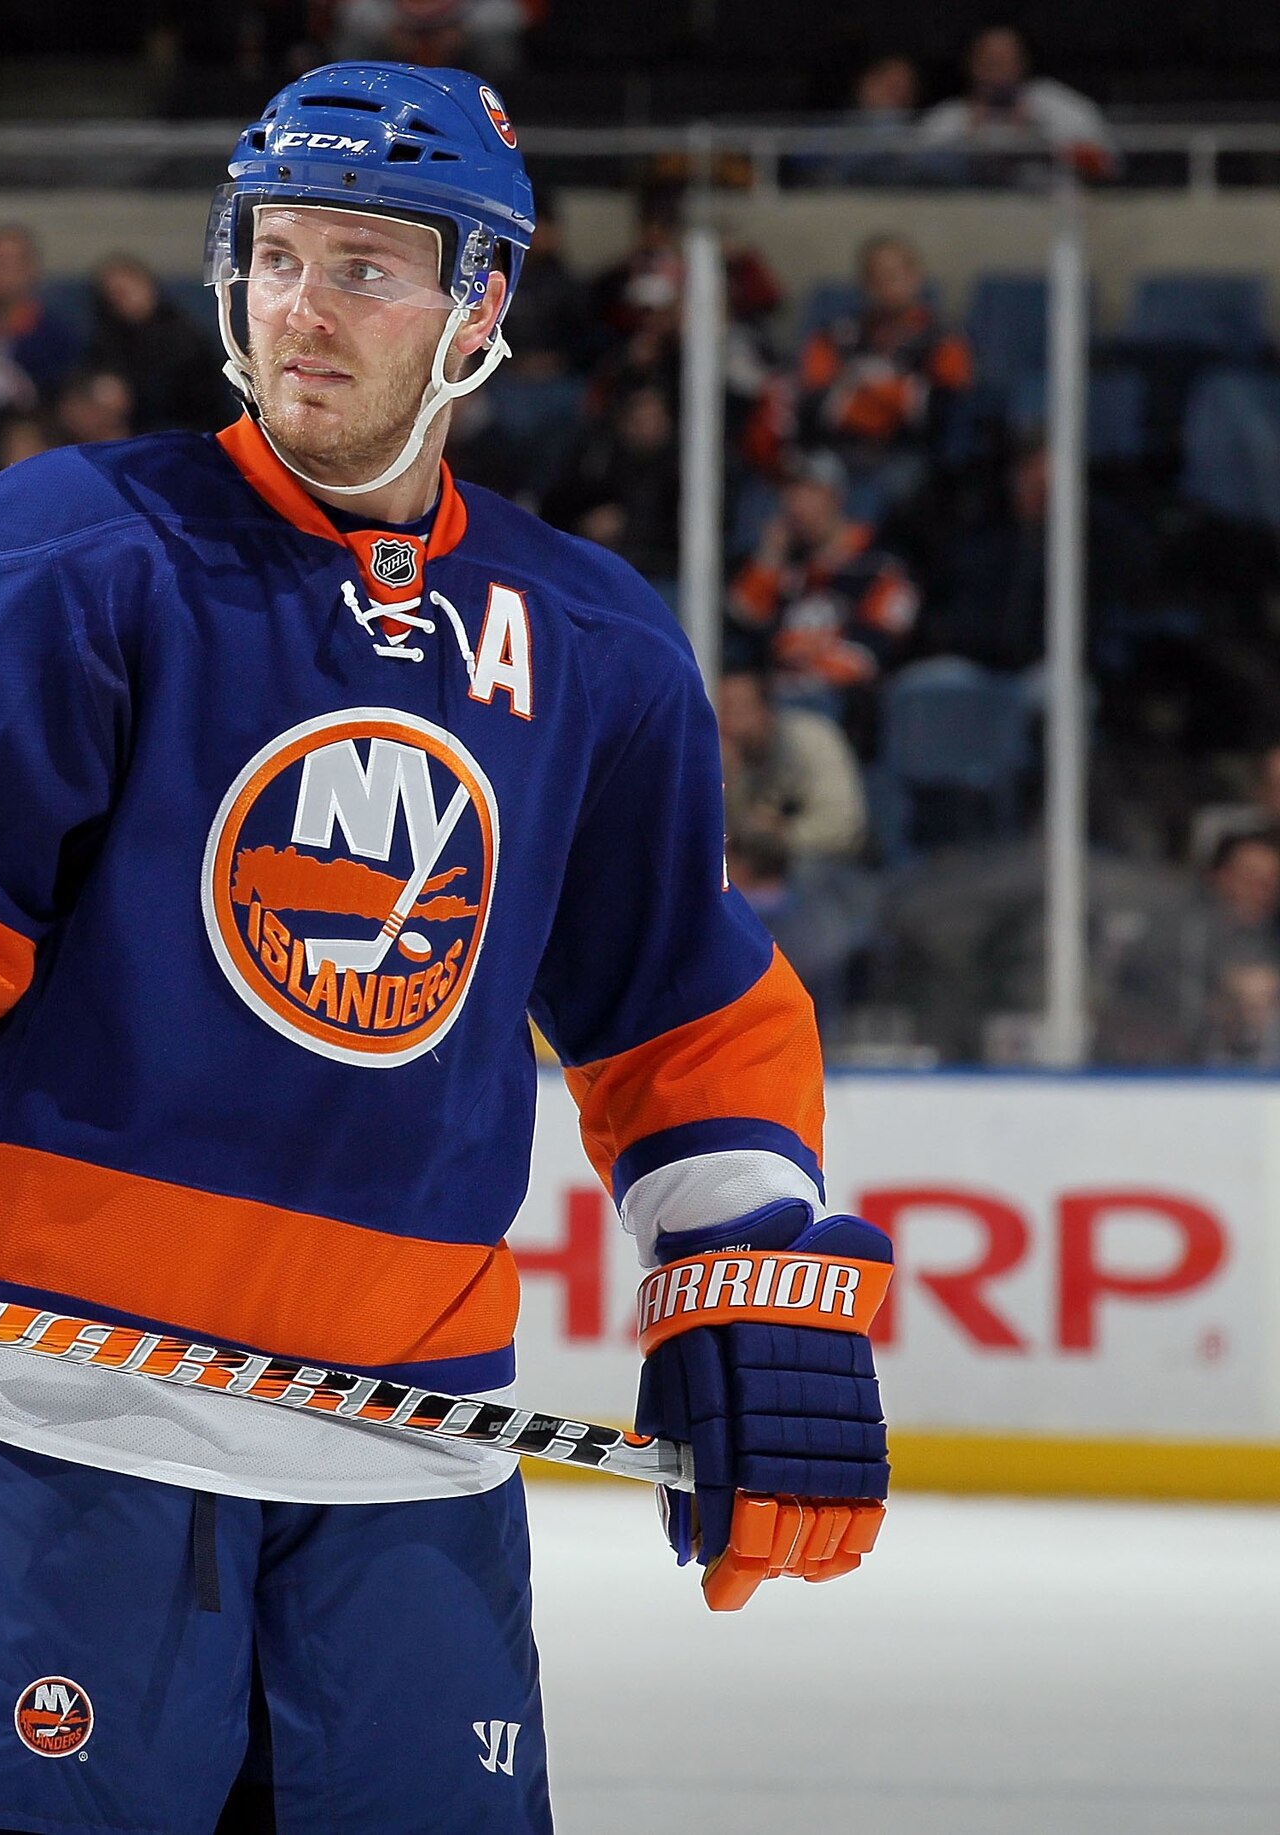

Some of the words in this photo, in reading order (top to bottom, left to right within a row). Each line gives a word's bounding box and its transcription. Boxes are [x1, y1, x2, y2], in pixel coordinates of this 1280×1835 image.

[275, 131, 370, 153] CCM
[382, 552, 408, 575] NHL
[468, 581, 534, 720] A
[291, 737, 471, 872] NY
[247, 901, 464, 1030] ISLANDERS
[637, 1257, 862, 1334] ARRIOR
[34, 1684, 79, 1716] NY
[22, 1719, 83, 1750] ISLANDERS
